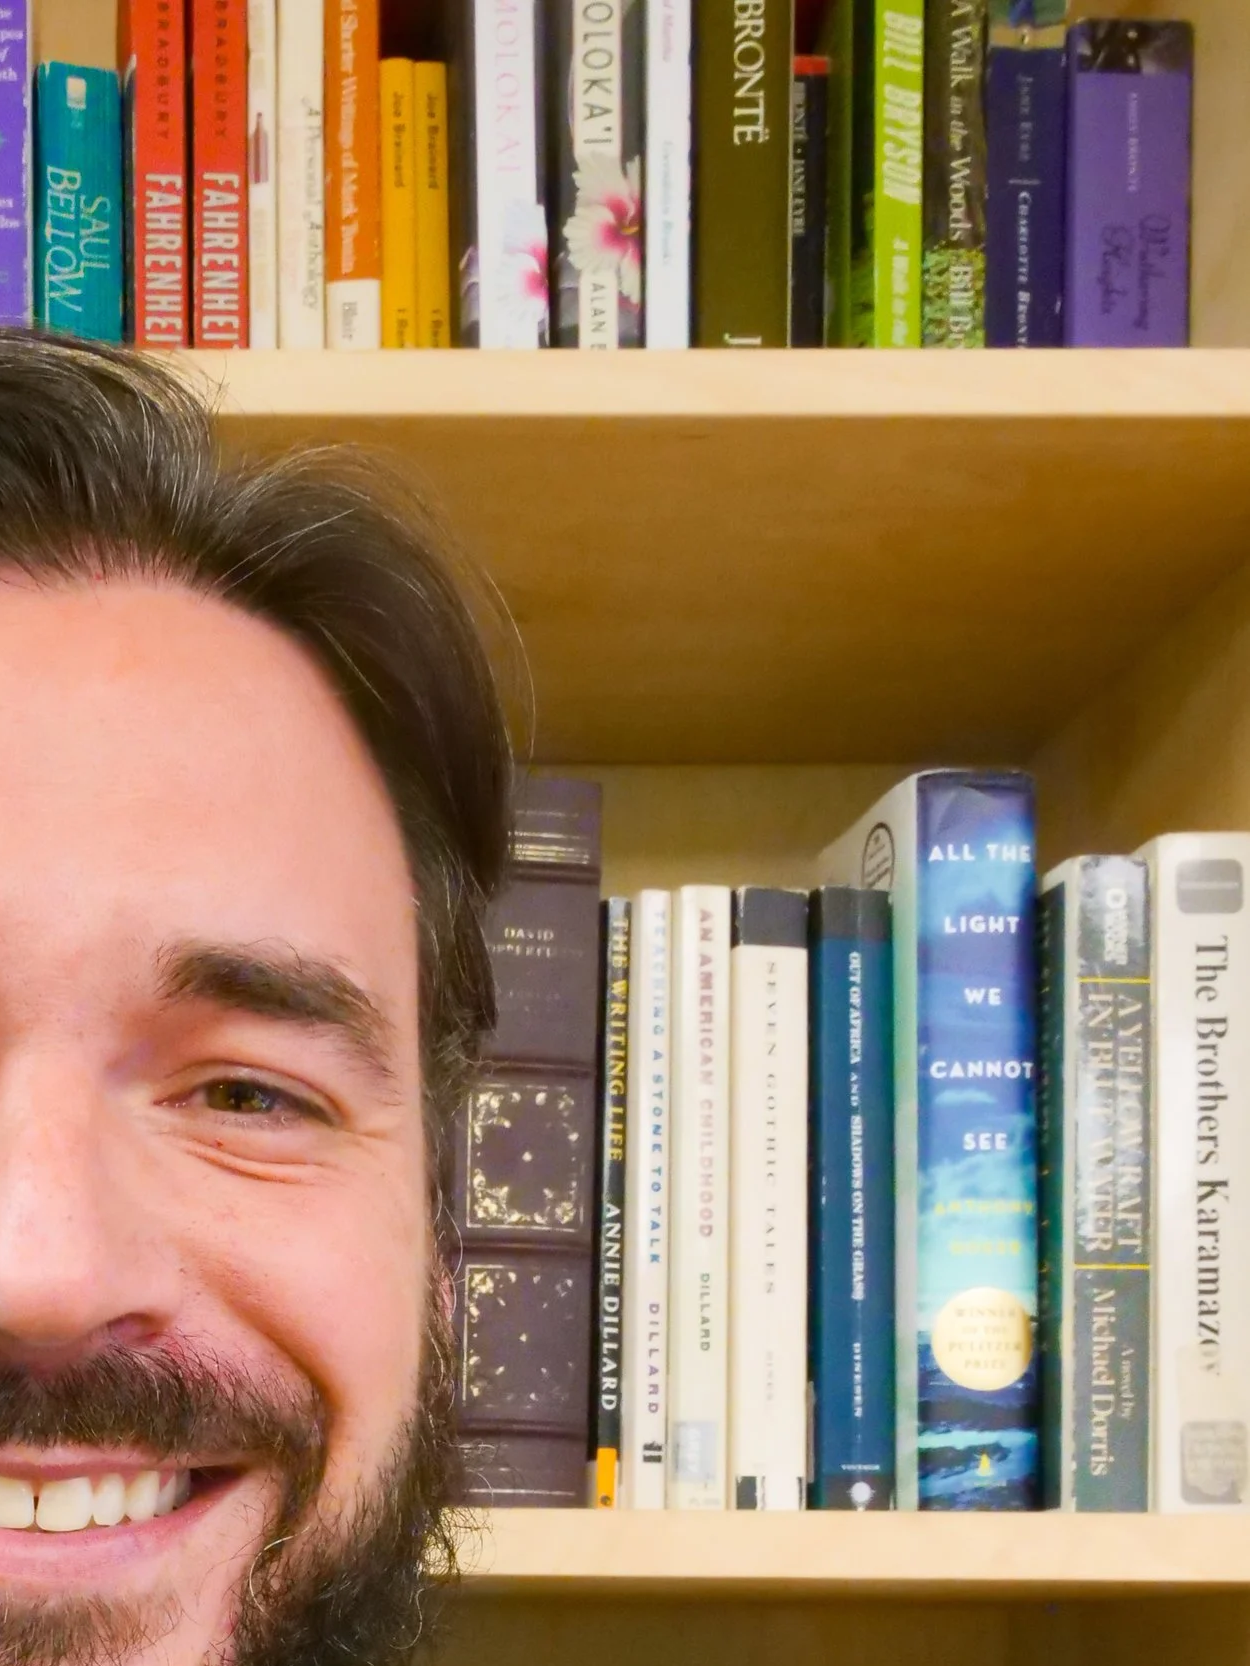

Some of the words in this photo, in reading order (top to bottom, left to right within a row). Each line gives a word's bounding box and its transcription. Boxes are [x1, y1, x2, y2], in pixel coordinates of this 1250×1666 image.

[882, 11, 923, 74] BILL
[950, 26, 973, 88] Walk
[881, 84, 923, 206] BRYSON
[78, 194, 112, 276] SAUL
[949, 155, 973, 242] Woods
[44, 164, 83, 313] BELLOW
[590, 282, 608, 333] ALAN
[928, 844, 976, 862] ALL
[986, 844, 1033, 863] THE
[611, 918, 630, 968] THE
[699, 908, 715, 943] AN
[944, 915, 1021, 934] LIGHT
[849, 951, 862, 983] OUT
[964, 987, 1002, 1006] WE
[1194, 934, 1230, 1003] The
[610, 979, 629, 1096] WRITING
[699, 953, 714, 1085] AMERICAN
[764, 959, 777, 1058] SEVEN
[849, 1007, 862, 1065] AFRICA
[1117, 994, 1143, 1017] A
[652, 1050, 664, 1062] A
[849, 1071, 860, 1107] AND
[930, 1060, 1035, 1080] CANNOT
[1194, 1015, 1231, 1164] Brothers
[609, 1105, 627, 1161] LIFE
[651, 1073, 664, 1154] STONE
[764, 1073, 777, 1186] GOTHIC
[963, 1132, 1008, 1152] SEE
[651, 1165, 662, 1193] TO
[698, 1098, 714, 1239] CHILDHOOD
[851, 1191, 864, 1213] ON
[650, 1206, 662, 1264] TALK
[1117, 1163, 1143, 1250] RAFT
[602, 1202, 623, 1287] ANNIE
[764, 1205, 777, 1296] TALES
[1195, 1176, 1231, 1376] Karamazov
[700, 1272, 711, 1352] DILLARD
[1091, 1286, 1117, 1388] Michael
[600, 1296, 621, 1411] DILLARD
[648, 1303, 661, 1414] DILLARD
[1090, 1393, 1117, 1477] Dorris
